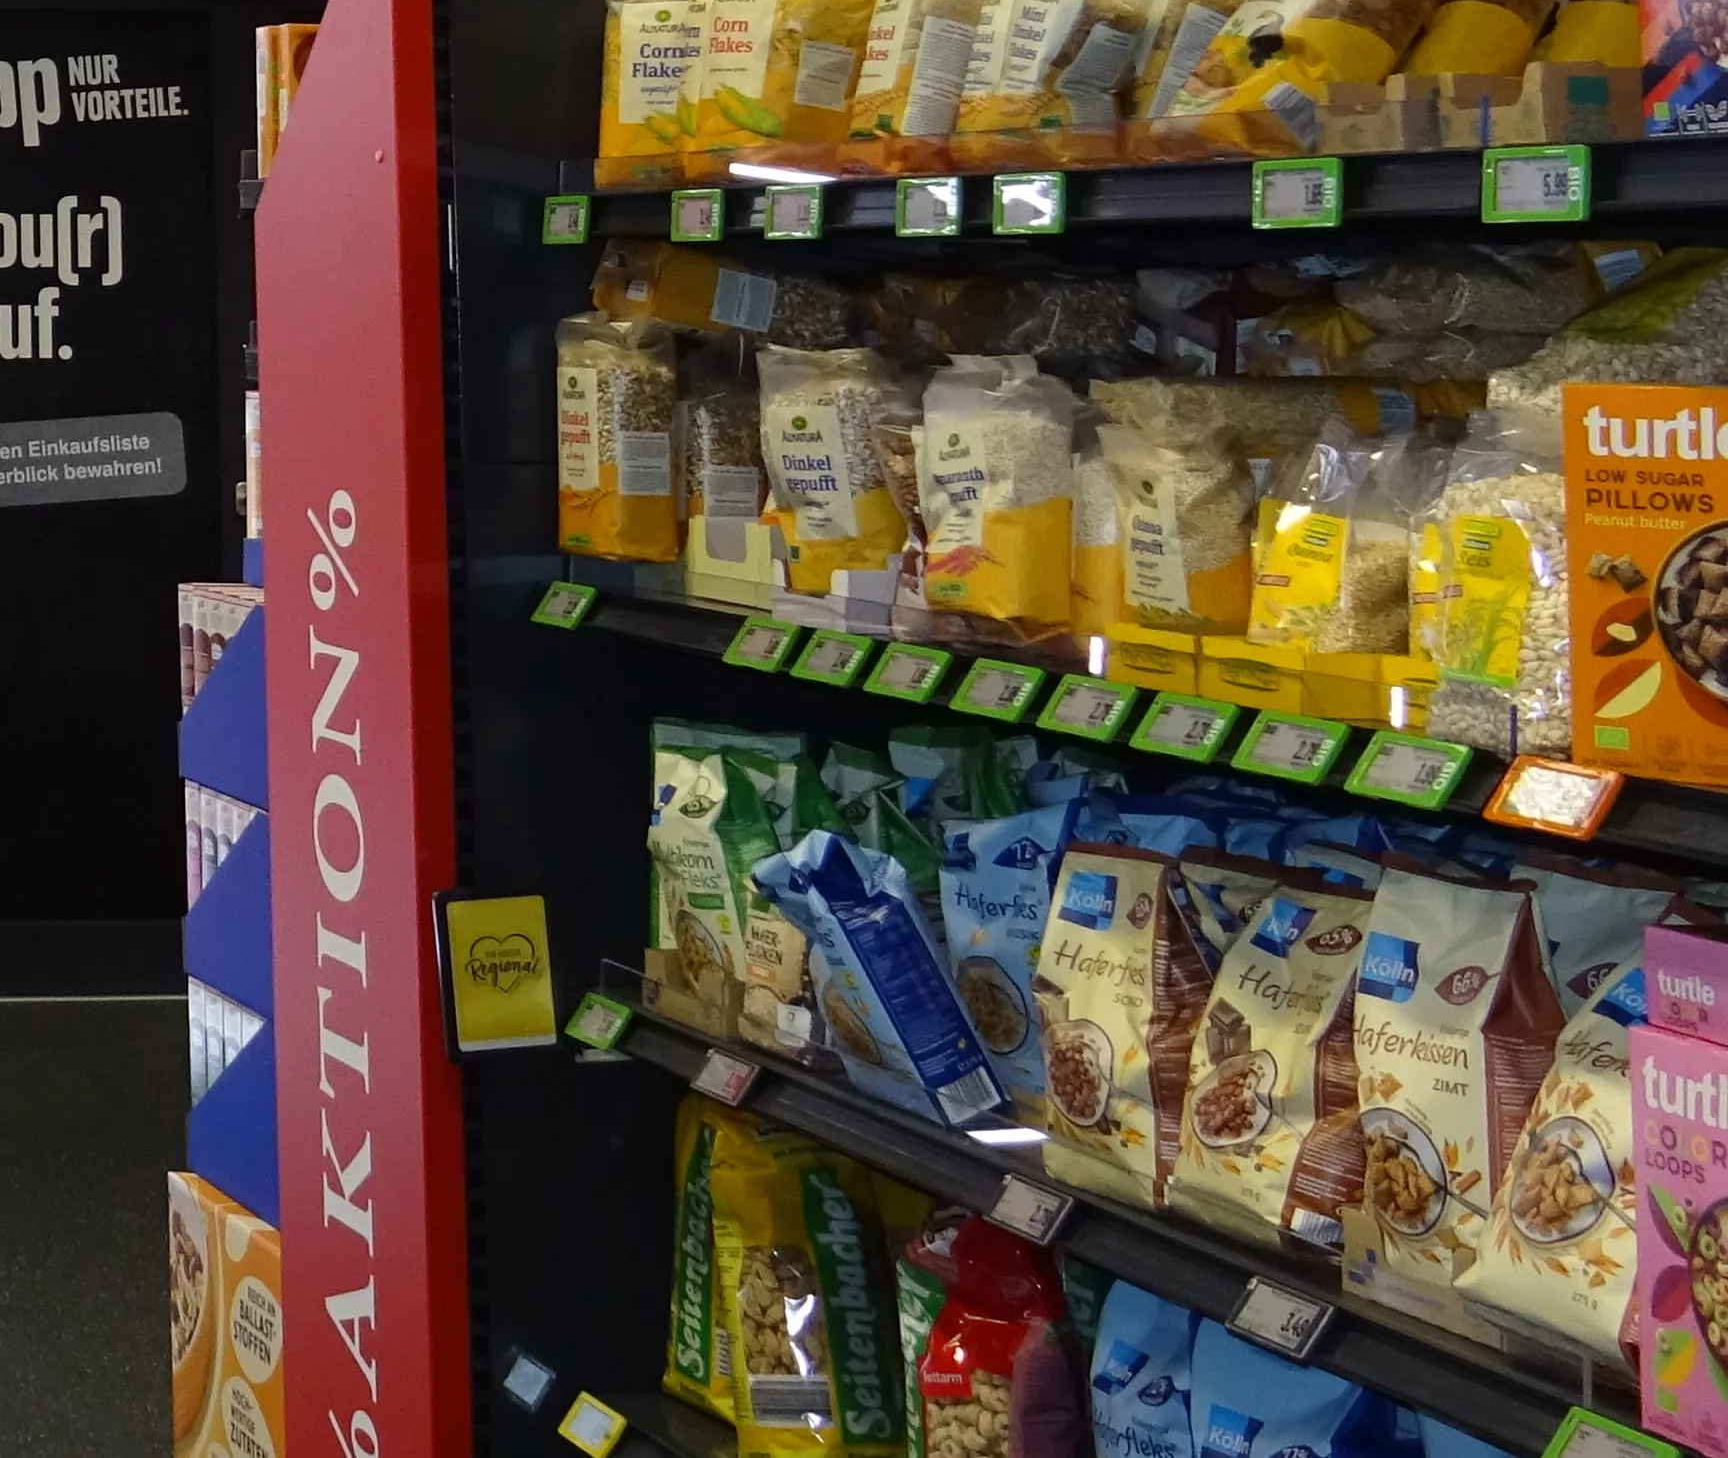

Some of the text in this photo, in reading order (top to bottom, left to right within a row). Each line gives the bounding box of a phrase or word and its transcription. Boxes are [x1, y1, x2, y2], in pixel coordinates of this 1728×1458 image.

[713, 16, 749, 33] Corn
[708, 38, 754, 54] Flakes
[67, 53, 121, 87] NUR
[71, 85, 191, 123] VORTEILE.
[27, 433, 151, 458] Einkaufsliste
[63, 457, 164, 481] bewahren!
[781, 454, 832, 472] Dinkel
[1585, 468, 1705, 488] LOW SUGAR
[1585, 488, 1715, 514] PILLOWS
[1584, 513, 1687, 530] Peanut butter
[1364, 953, 1416, 984] Kölln
[1657, 969, 1716, 1006] turtle
[1432, 1077, 1470, 1097] ZIMT
[1645, 1146, 1707, 1185] LOOPS
